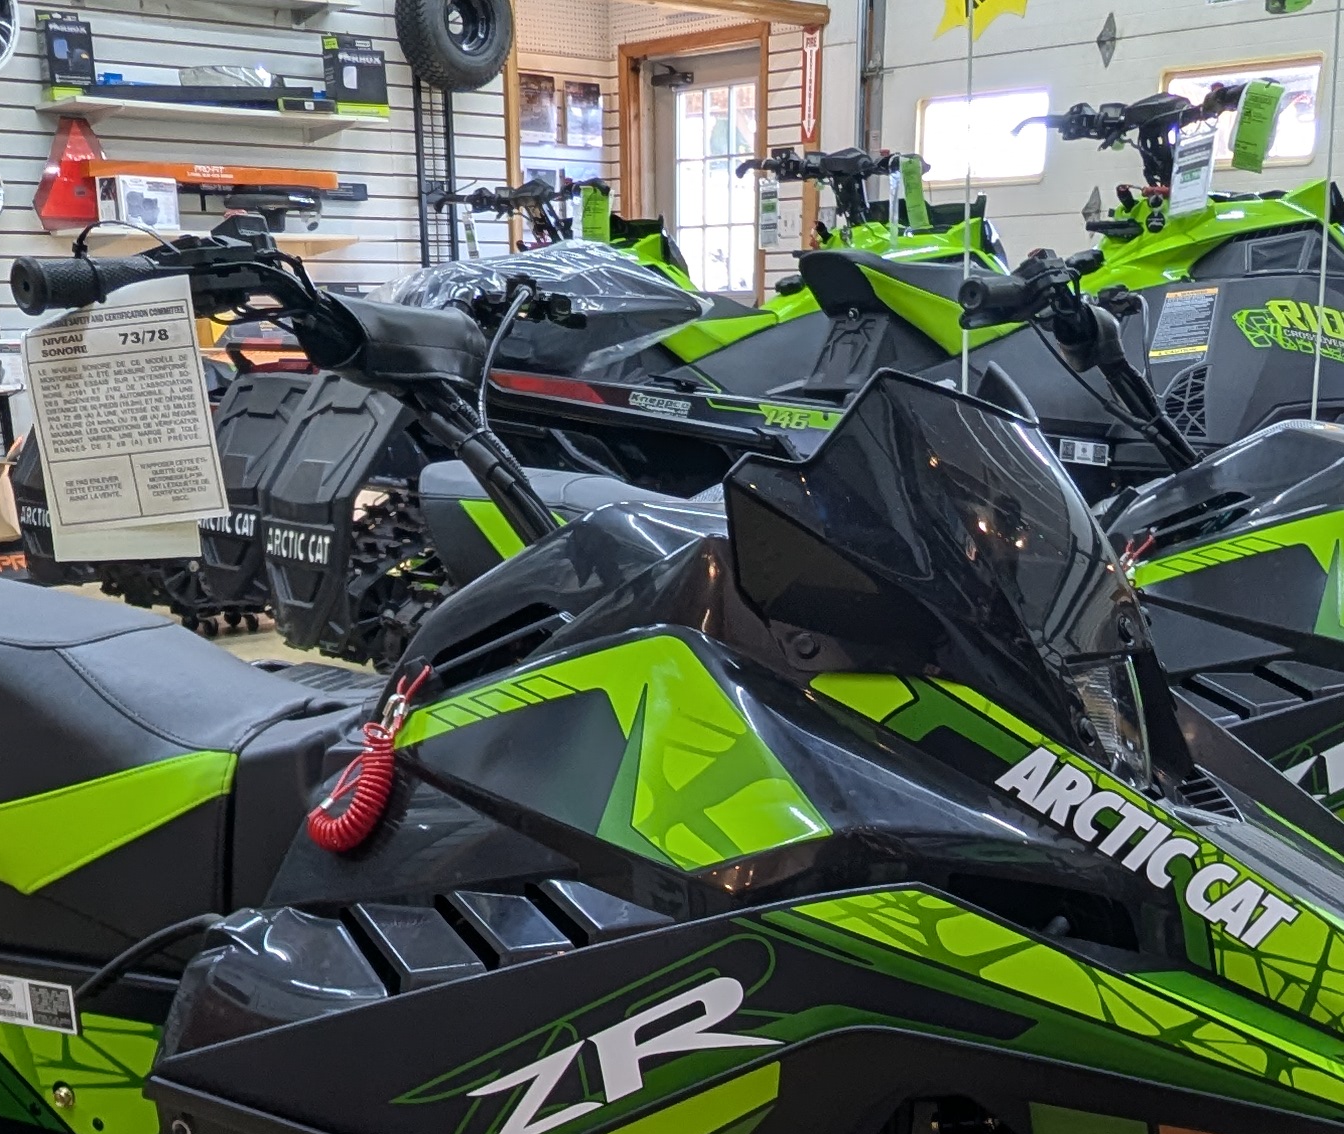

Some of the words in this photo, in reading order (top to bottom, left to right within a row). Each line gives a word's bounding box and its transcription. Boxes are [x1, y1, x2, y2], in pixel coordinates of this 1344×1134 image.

[104, 309, 148, 321] CERTIFICATION
[41, 334, 83, 345] NIVEAU
[118, 328, 169, 345] 73/78
[40, 345, 88, 357] SONORE
[764, 409, 810, 430] 146
[21, 505, 51, 528] ARCTIC
[234, 512, 257, 537] CAT
[266, 527, 306, 561] ARCTIC
[308, 534, 331, 565] CAT
[994, 744, 1200, 888] ARCTIC
[1183, 860, 1304, 950] CAT
